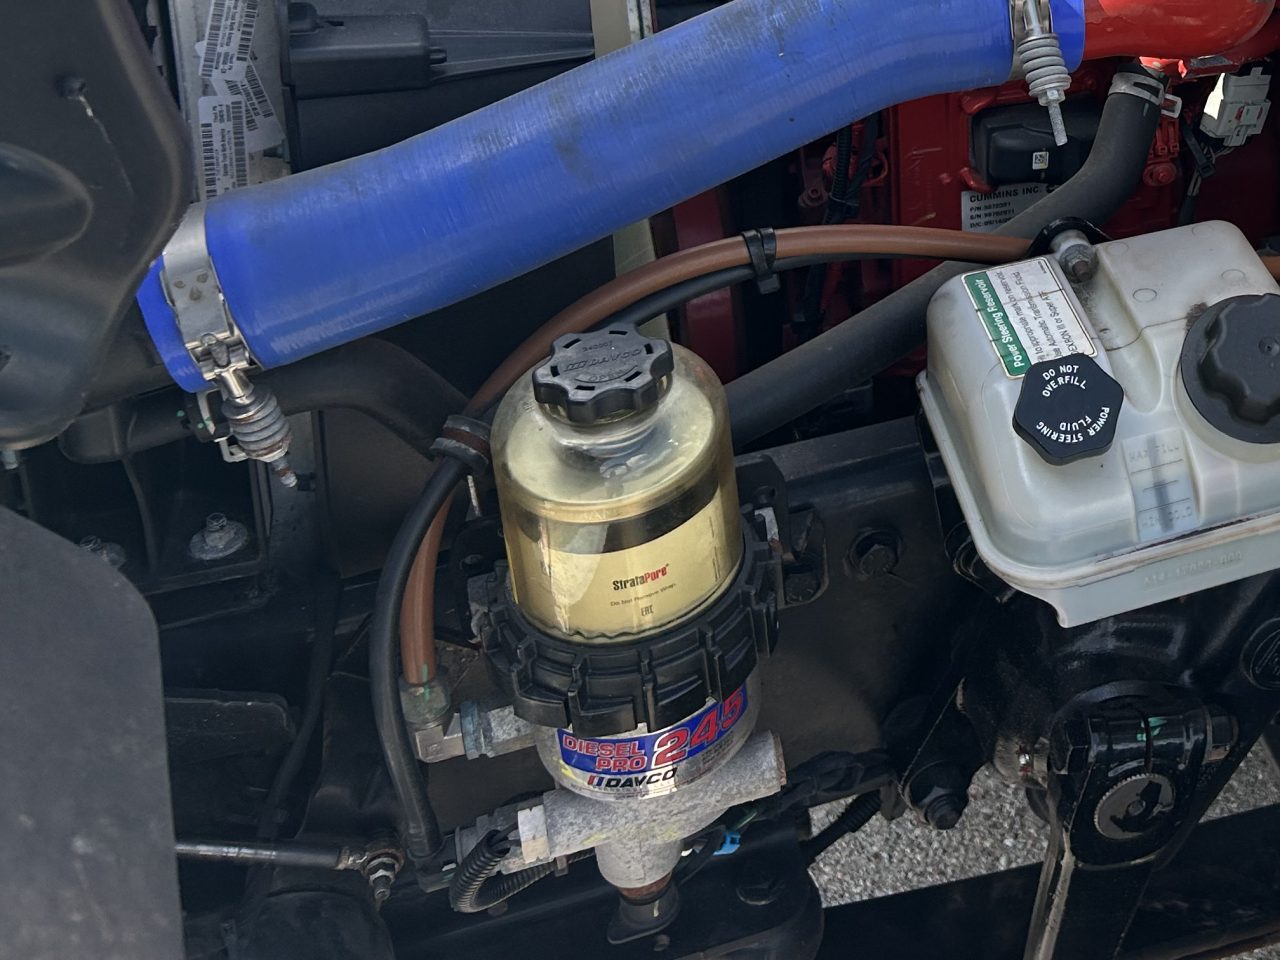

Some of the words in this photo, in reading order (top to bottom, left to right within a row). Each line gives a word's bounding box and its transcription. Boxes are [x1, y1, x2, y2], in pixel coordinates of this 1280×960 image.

[970, 188, 1018, 203] CUMMINS
[1011, 270, 1025, 286] Fluid
[974, 277, 998, 314] Reservoir
[1018, 284, 1043, 321] Transmission
[1045, 300, 1059, 319] Super
[991, 310, 1013, 345] Steering
[1036, 318, 1058, 349] Automatic
[1006, 342, 1025, 369] Power
[1043, 368, 1055, 381] DO
[1060, 365, 1079, 373] NOT
[1042, 376, 1087, 397] OVERFILL
[1036, 421, 1083, 442] STEERING
[1059, 416, 1091, 430] FLUID
[1089, 407, 1109, 436] POWER
[612, 565, 668, 591] StrataPore
[652, 688, 743, 769] 245
[563, 735, 645, 757] DIESEL
[596, 756, 647, 772] PRO
[604, 768, 678, 789] DAVCO
